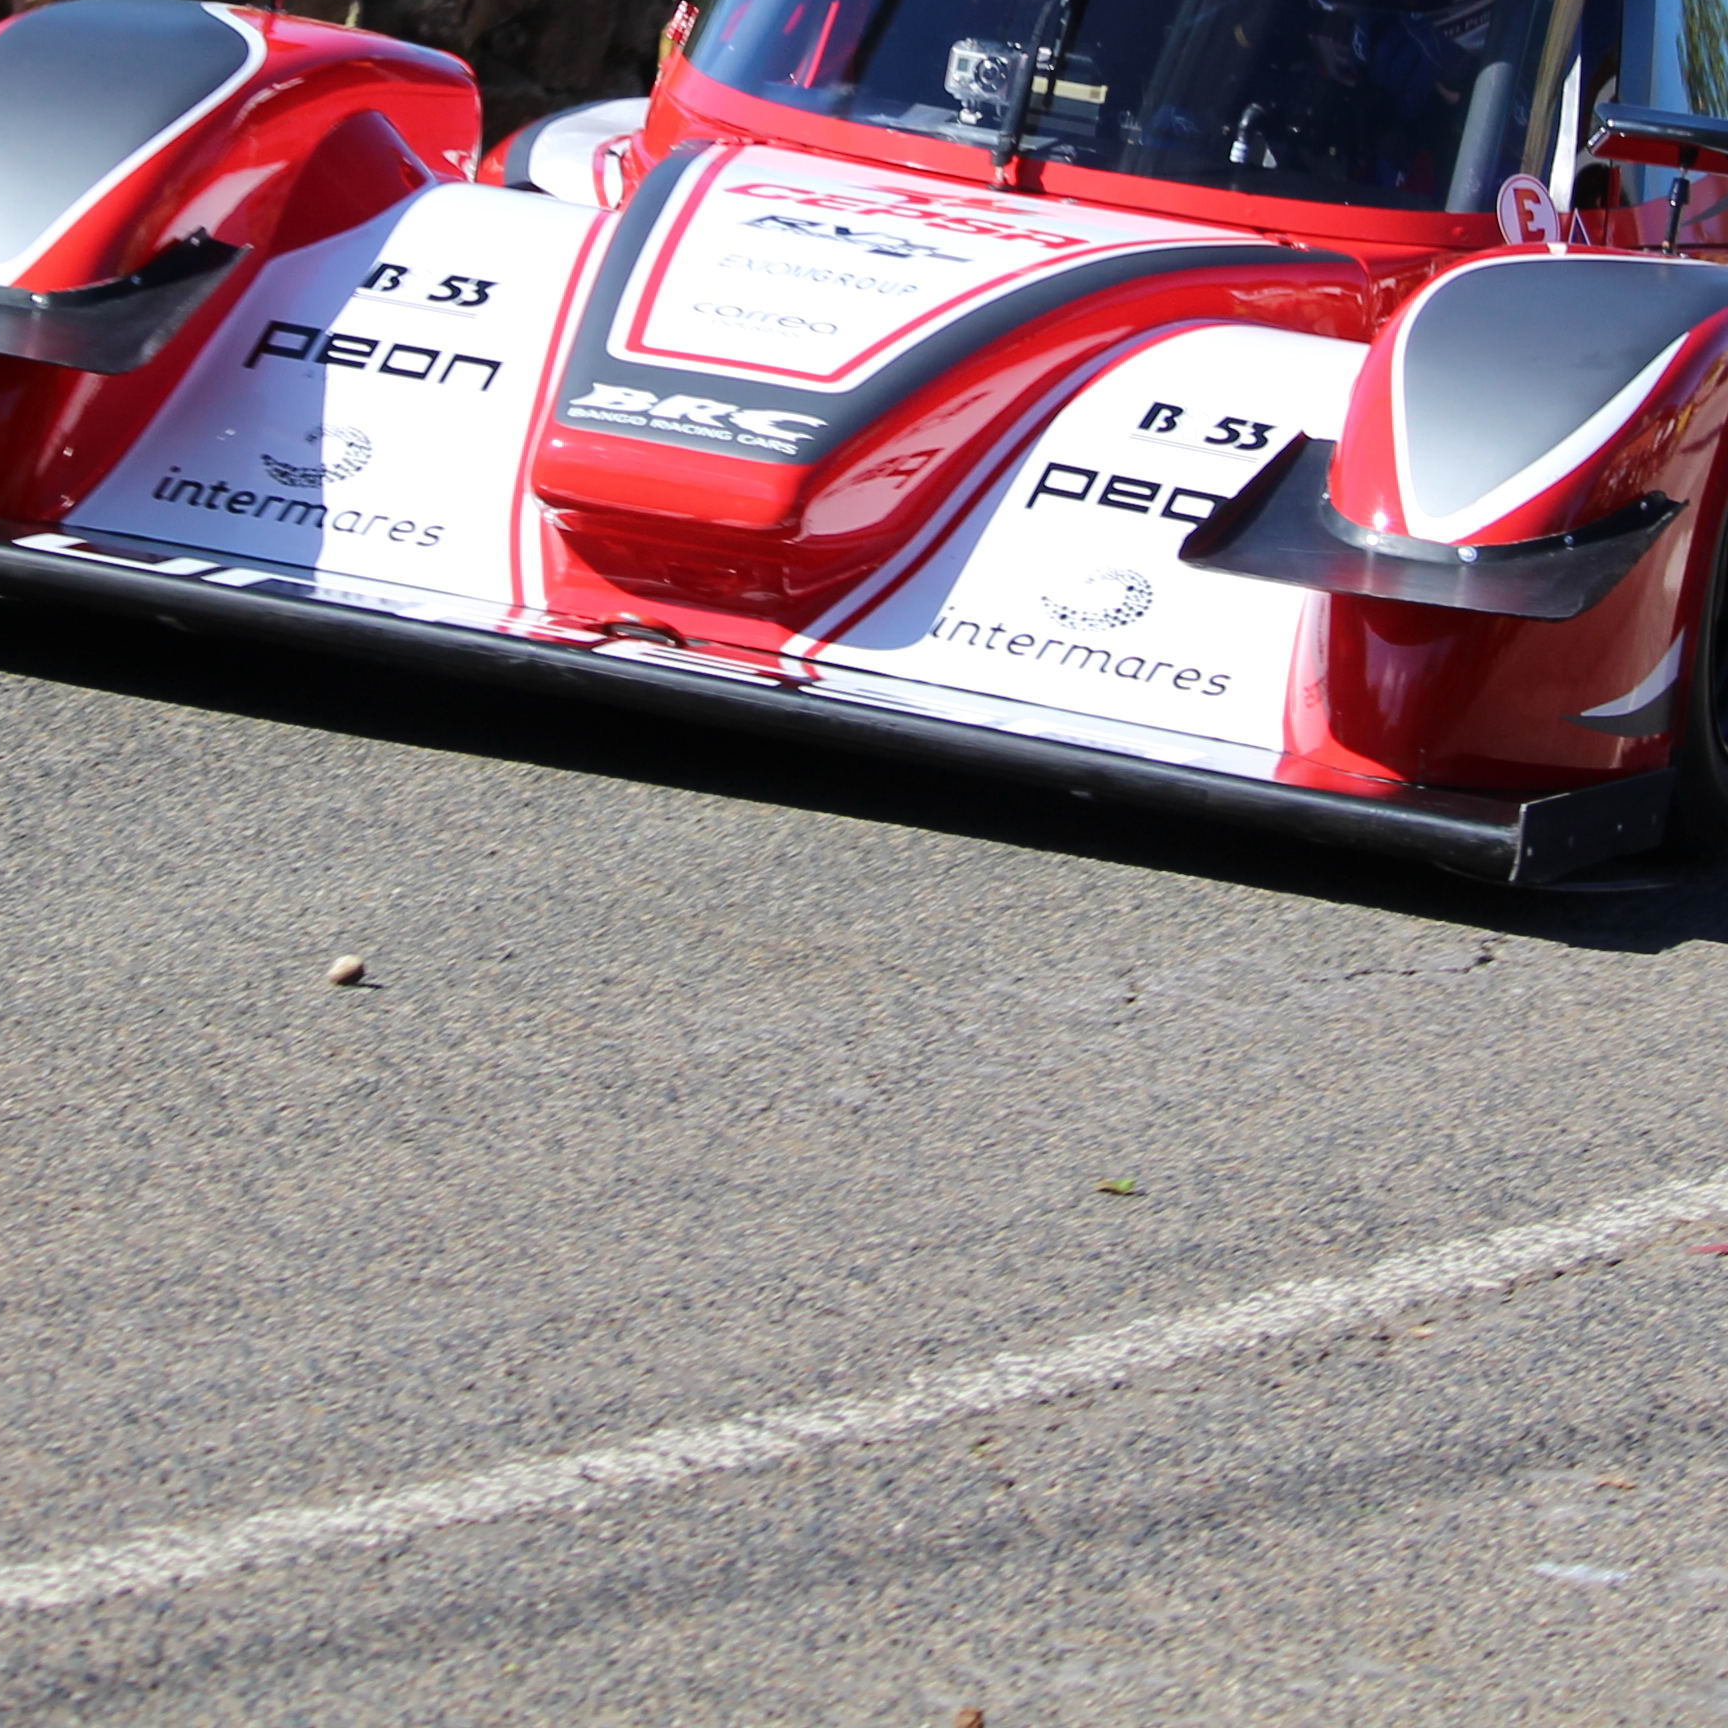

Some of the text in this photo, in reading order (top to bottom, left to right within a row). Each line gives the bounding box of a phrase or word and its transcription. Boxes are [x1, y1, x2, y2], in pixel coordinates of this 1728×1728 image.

[724, 183, 1090, 249] CEPSA
[1513, 187, 1545, 243] E
[692, 300, 839, 335] correa
[242, 319, 503, 392] peon
[567, 406, 799, 456] BANGO RACING CARS
[569, 382, 829, 441] BRC
[153, 465, 445, 547] intermares
[1025, 461, 1234, 525] peo
[928, 605, 1232, 698] intermares
